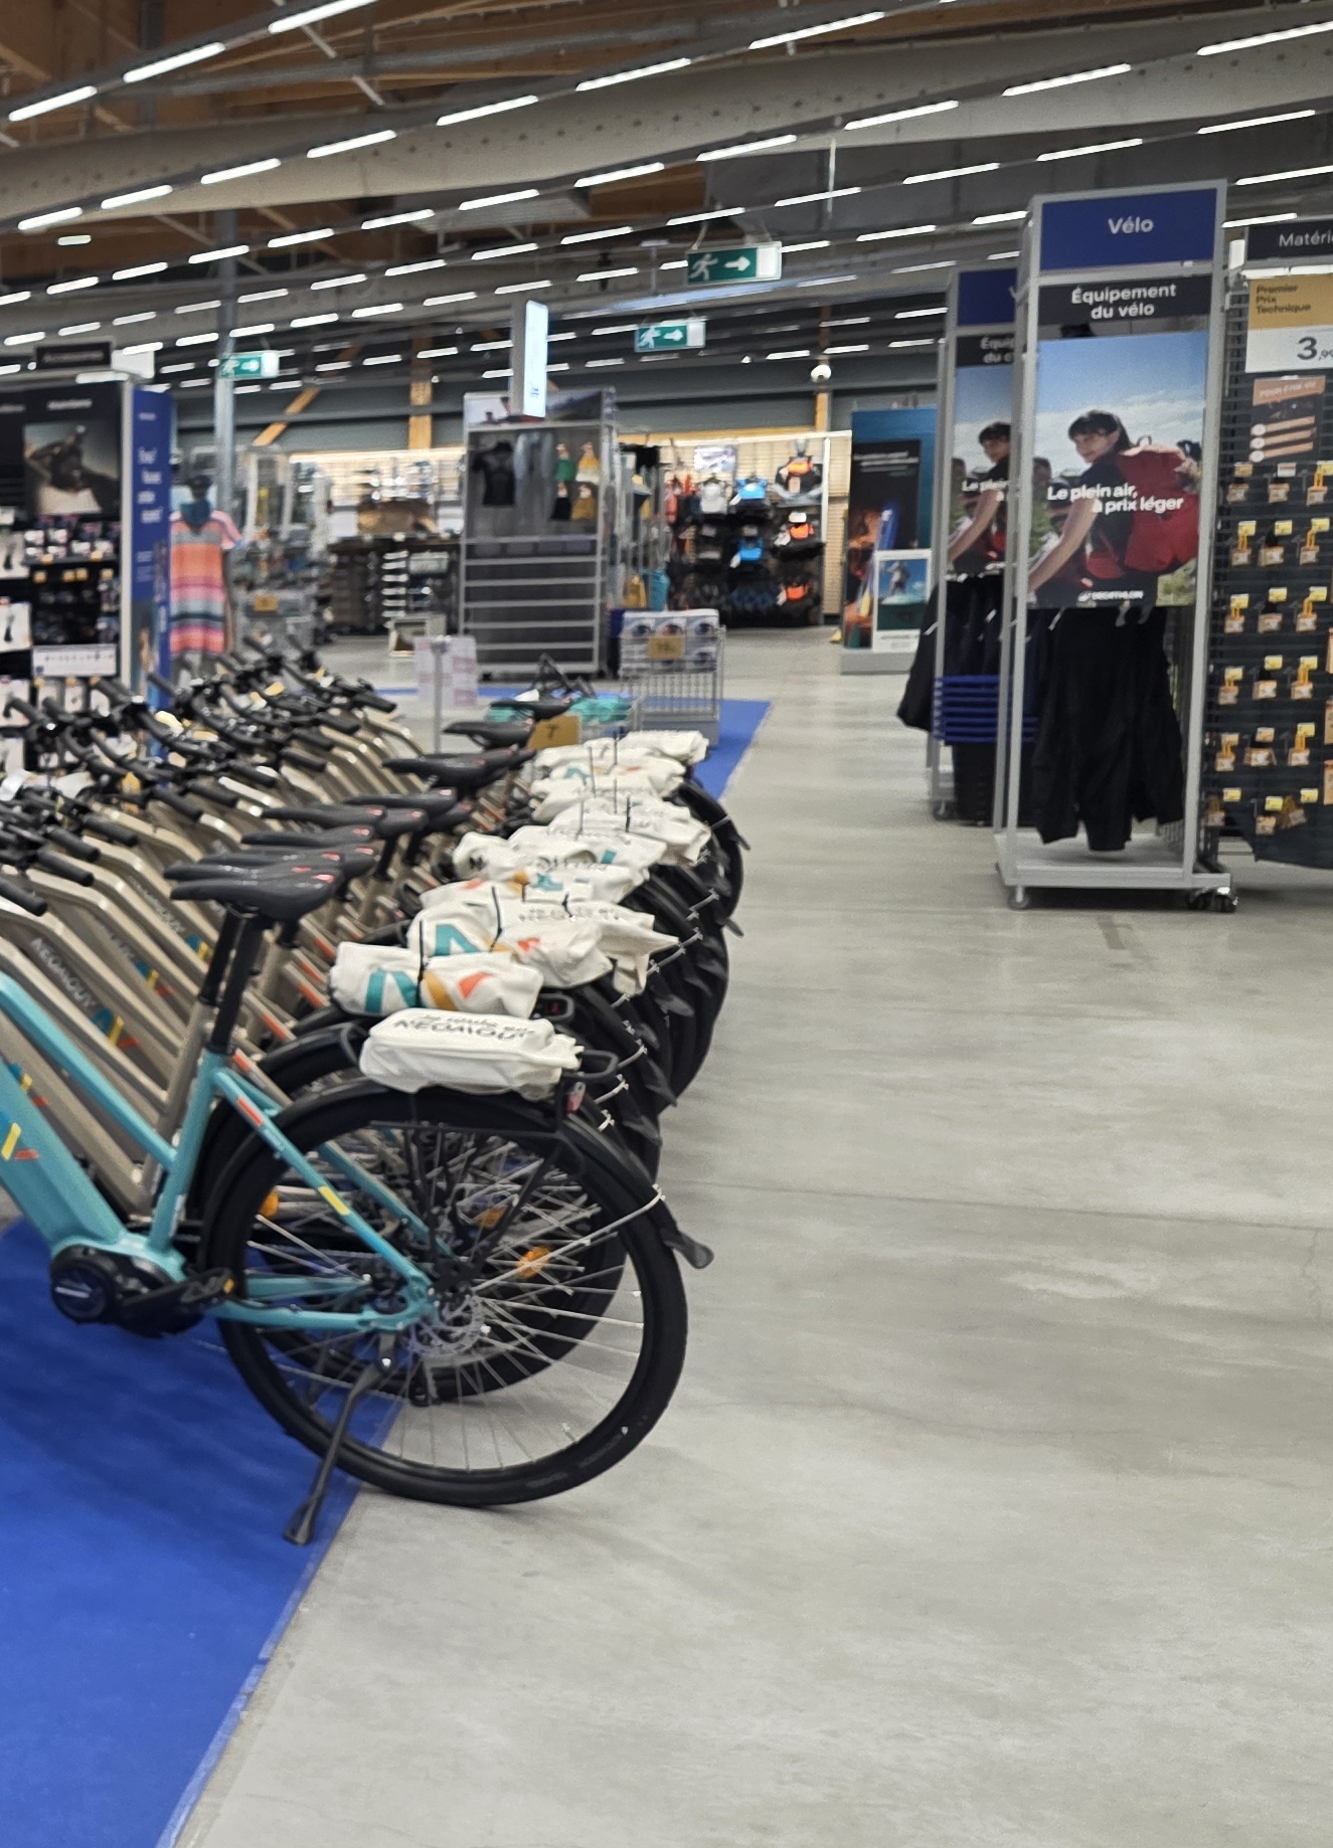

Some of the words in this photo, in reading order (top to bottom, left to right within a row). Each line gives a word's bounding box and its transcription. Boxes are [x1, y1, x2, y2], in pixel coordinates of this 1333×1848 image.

[1107, 216, 1154, 235] Vélo
[1279, 230, 1333, 248] Matéri
[1071, 283, 1177, 305] Équipement
[1091, 305, 1114, 320] du
[1118, 302, 1155, 318] vélo
[1047, 485, 1068, 500] Le
[1071, 483, 1111, 502] plein
[1113, 482, 1138, 498] air,
[1105, 497, 1137, 515] prix
[1140, 495, 1184, 513] léger
